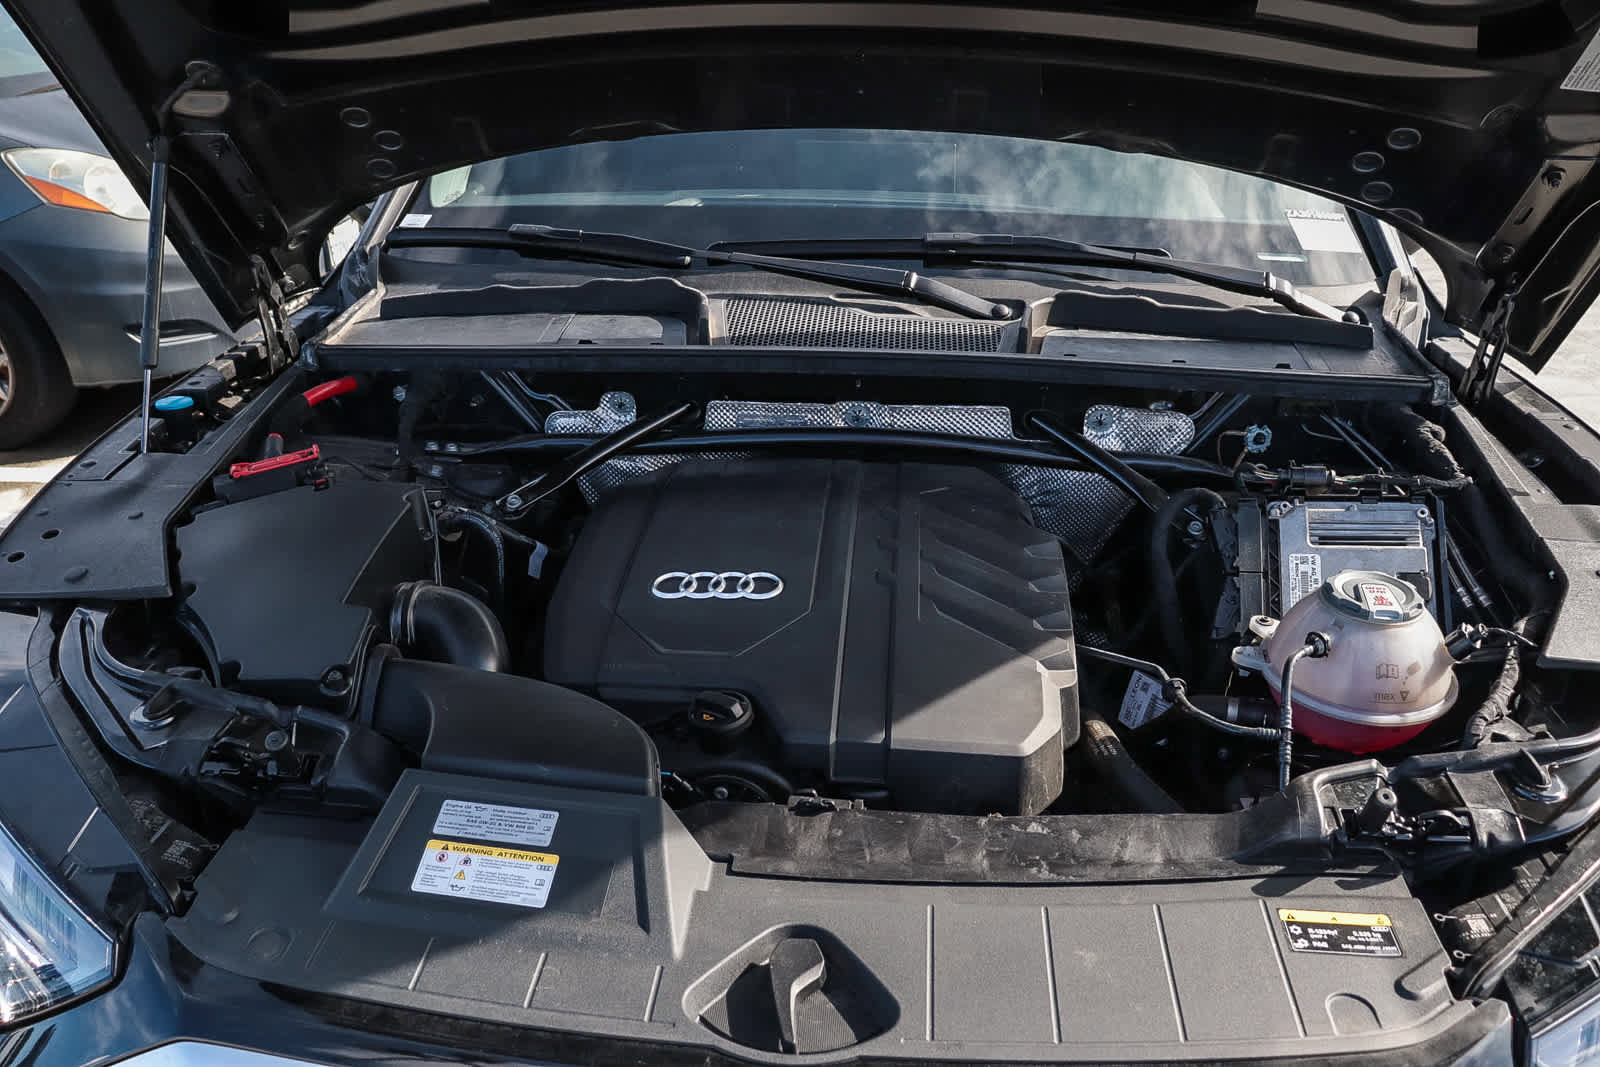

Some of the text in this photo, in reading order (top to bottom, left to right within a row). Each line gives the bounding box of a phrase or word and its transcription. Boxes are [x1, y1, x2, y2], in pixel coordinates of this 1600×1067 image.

[1310, 555, 1317, 566] VW
[1311, 567, 1317, 577] AG
[1375, 692, 1395, 702] max
[452, 844, 545, 862] WARNING ATTENTION
